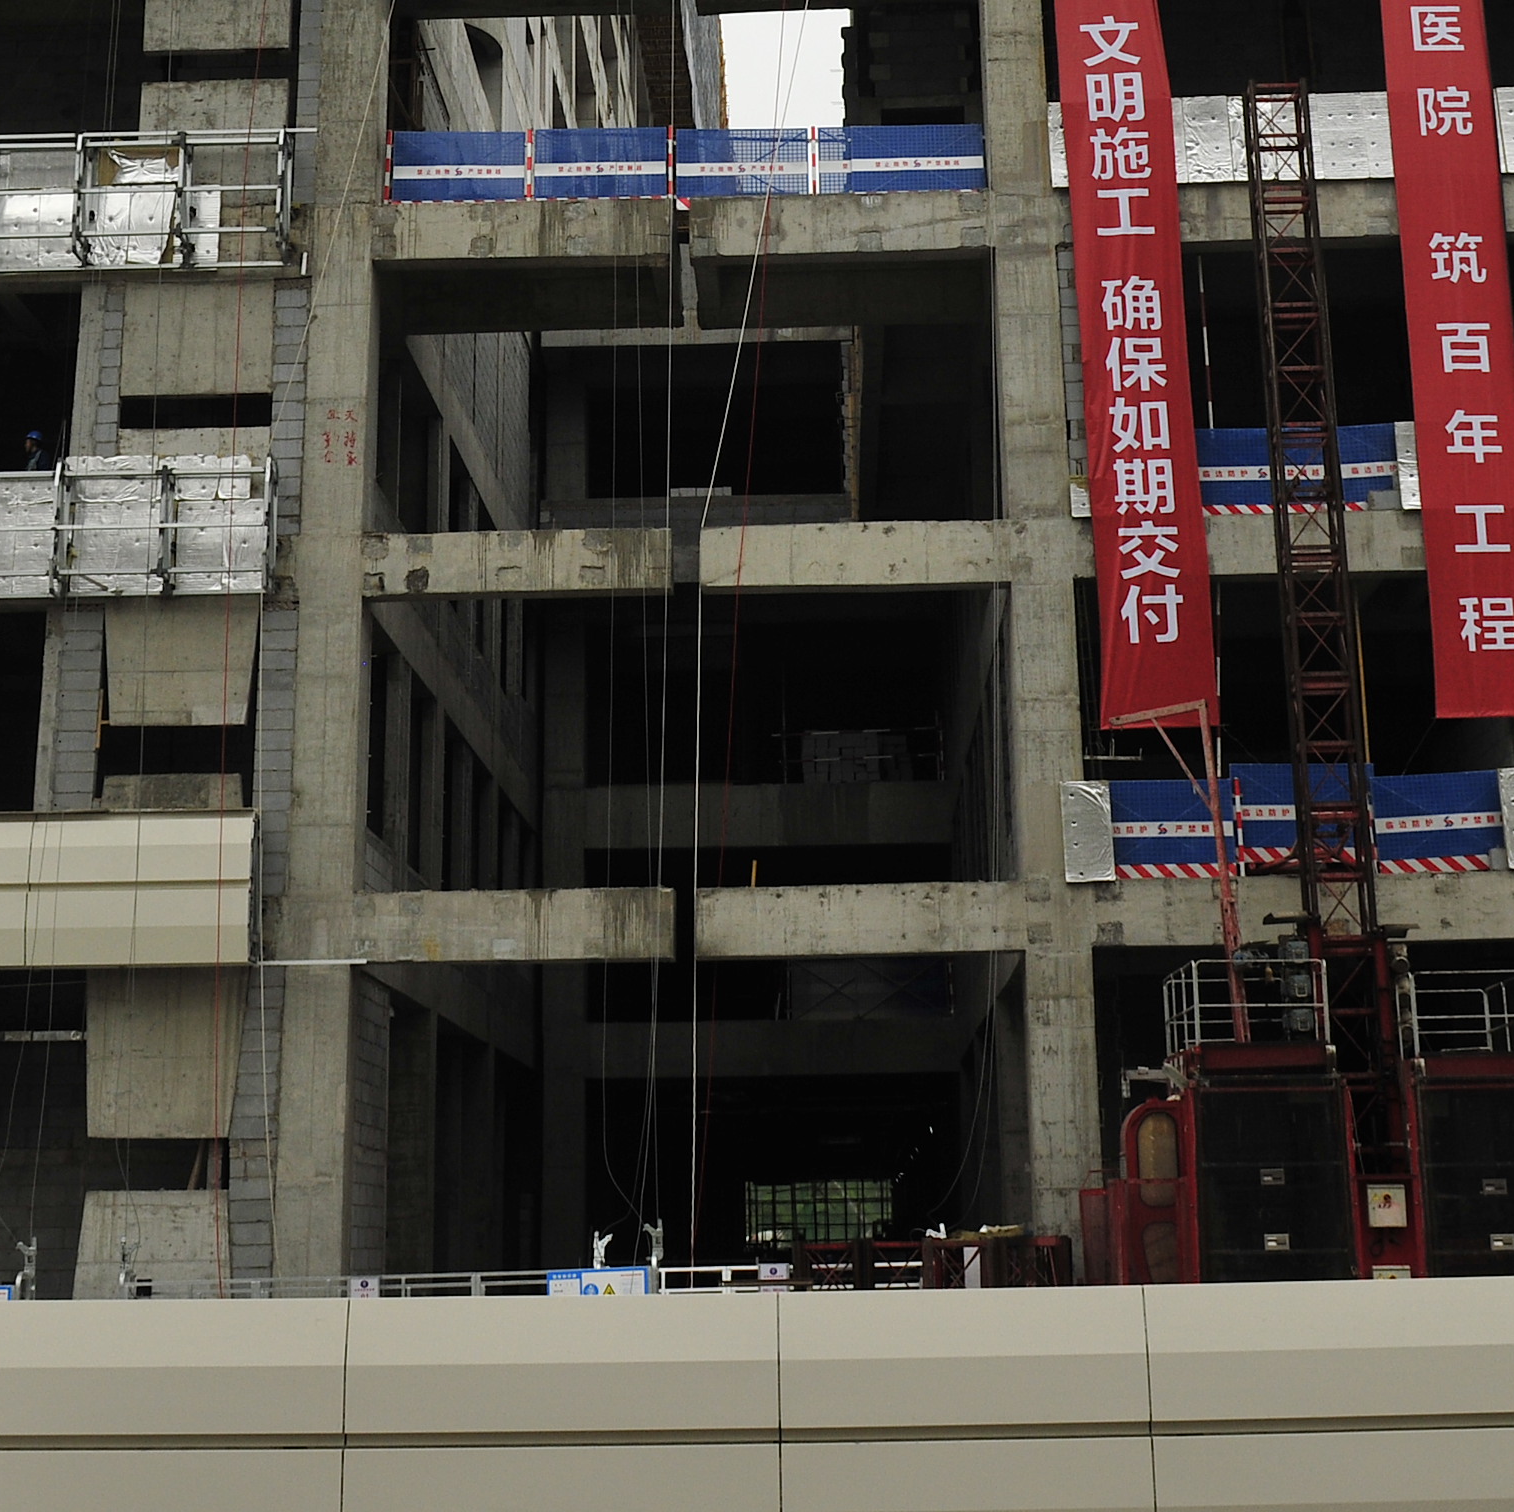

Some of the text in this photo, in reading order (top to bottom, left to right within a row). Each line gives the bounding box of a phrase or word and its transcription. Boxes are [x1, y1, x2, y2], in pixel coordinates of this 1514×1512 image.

[1079, 15, 1156, 236] 文明施工
[1101, 275, 1184, 644] 确保如期交付
